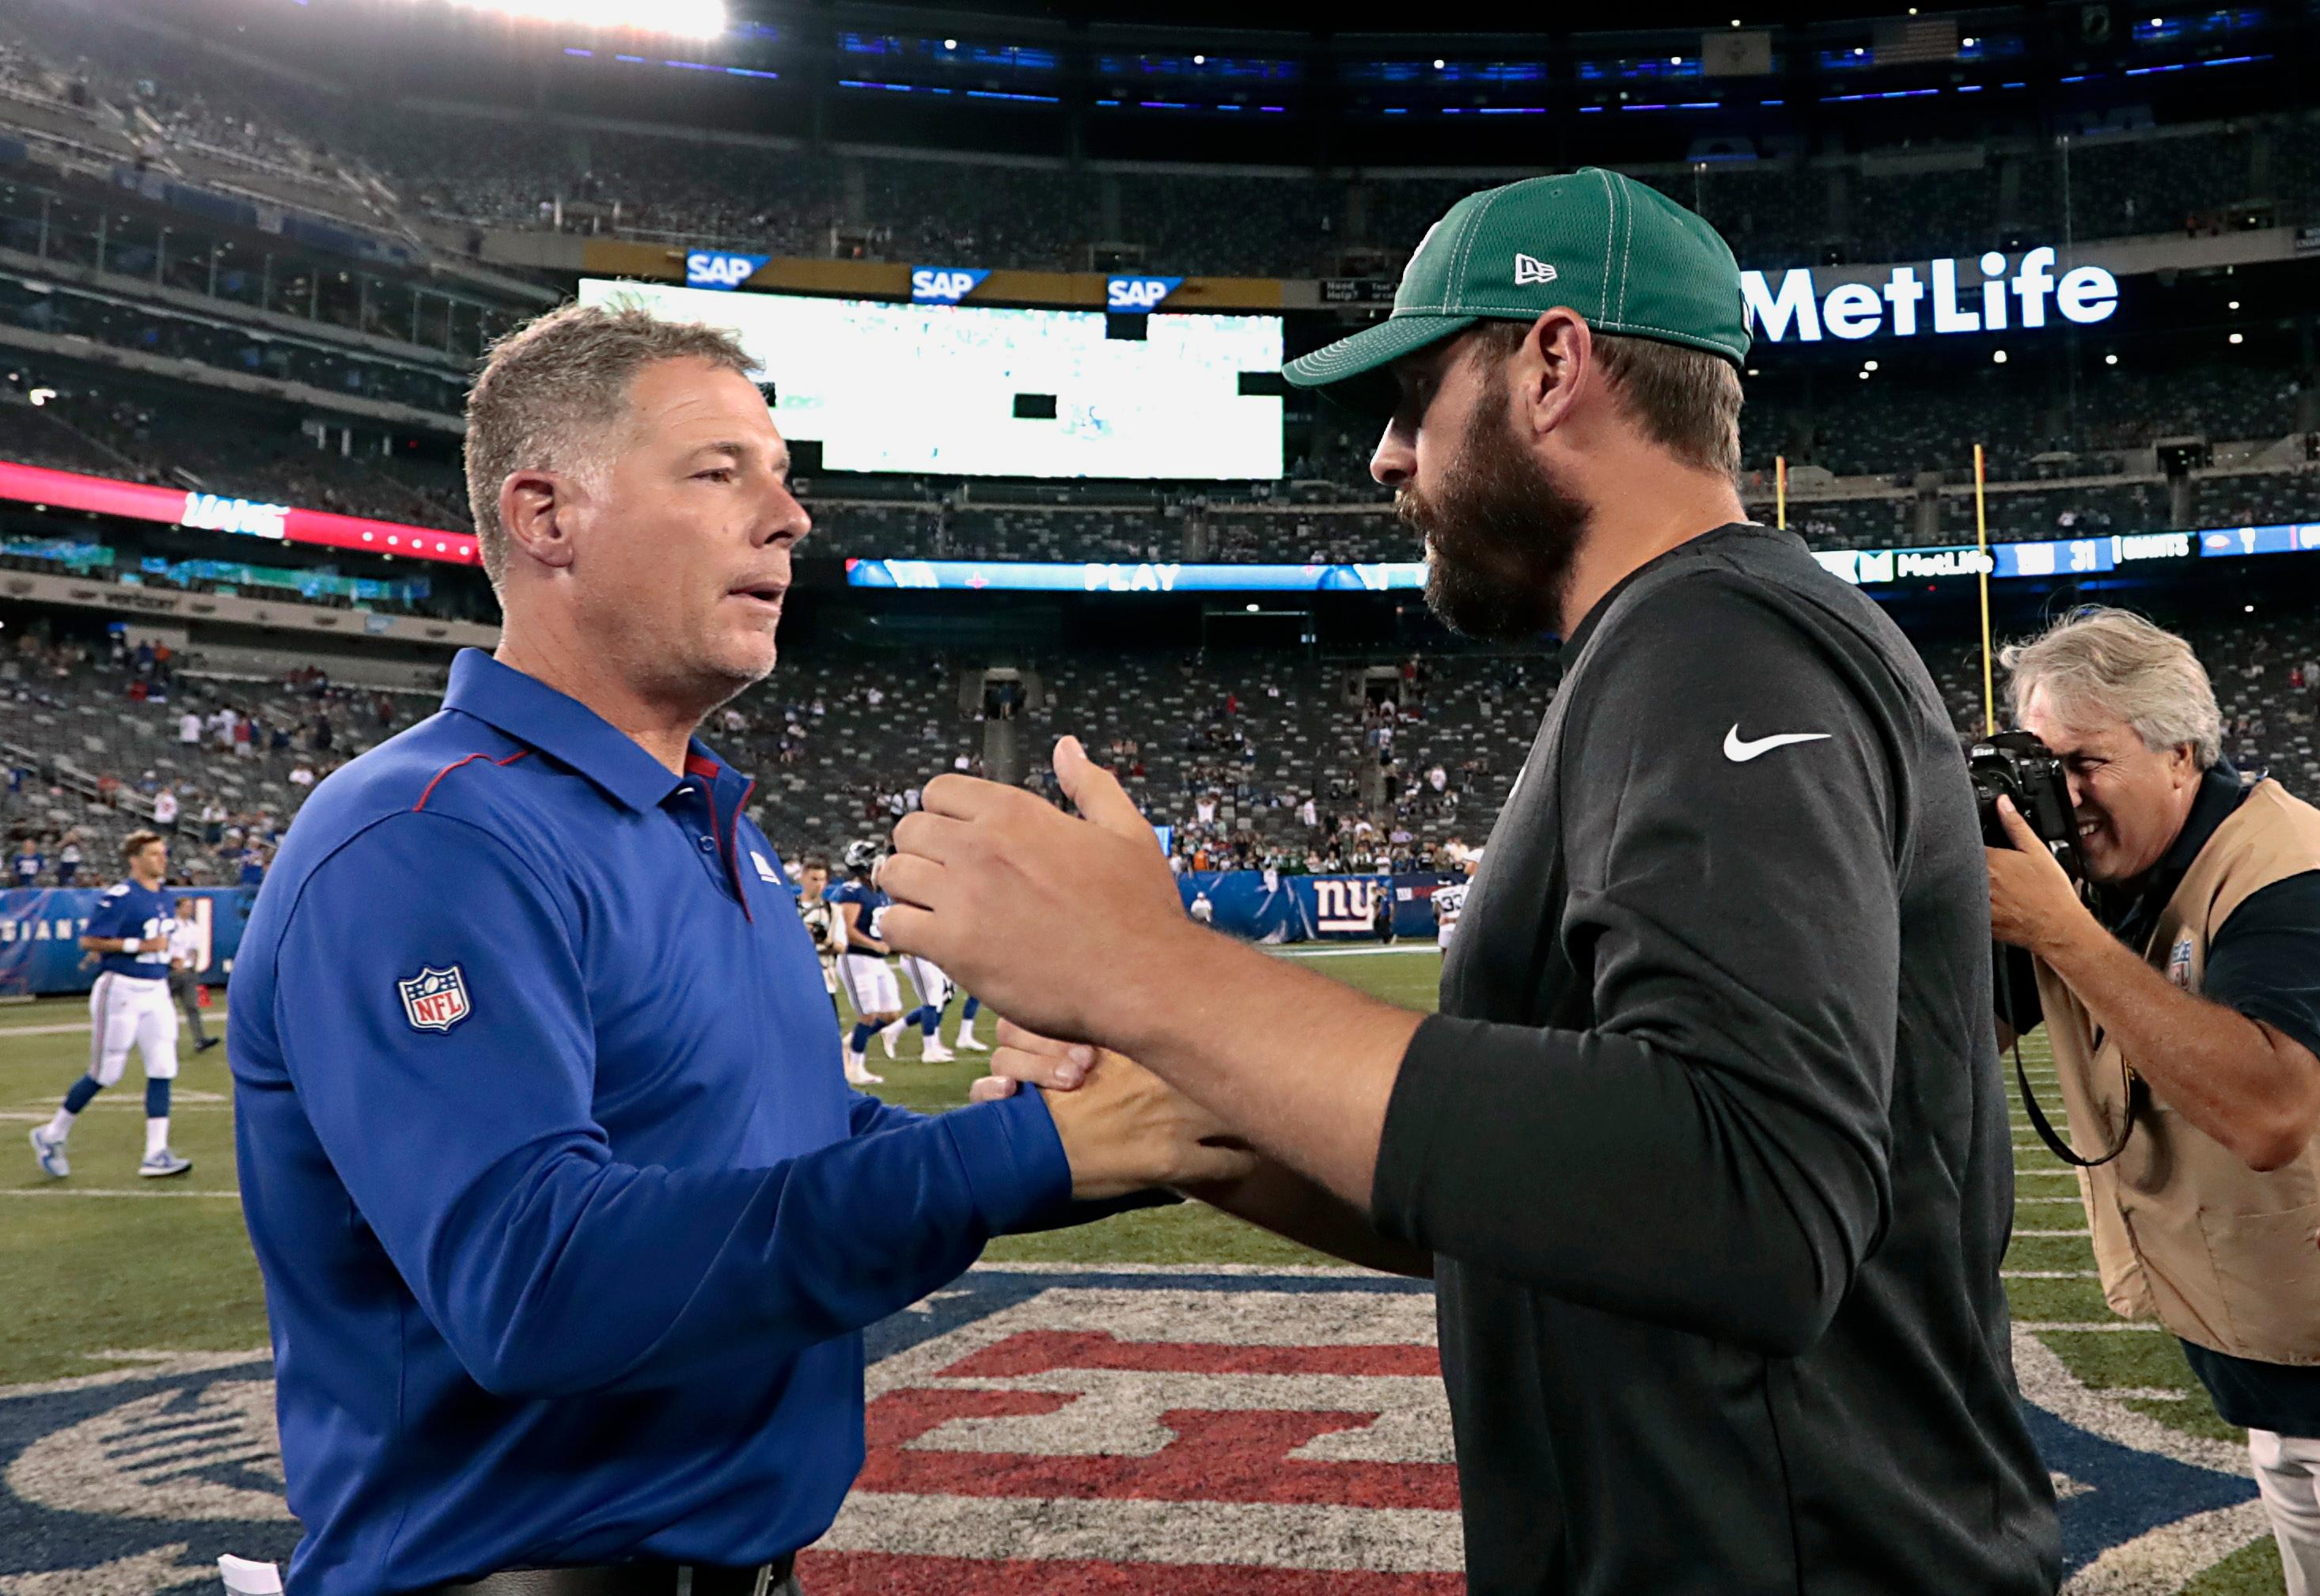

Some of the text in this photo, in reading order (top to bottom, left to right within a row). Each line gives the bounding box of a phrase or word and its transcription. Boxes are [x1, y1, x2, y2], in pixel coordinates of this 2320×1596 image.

[687, 254, 752, 285] SAP
[912, 271, 974, 300] SAP
[1108, 280, 1167, 307] SAP
[1741, 247, 2118, 342] MetLife
[1084, 563, 1181, 591] PLAY
[415, 991, 463, 1022] NFL
